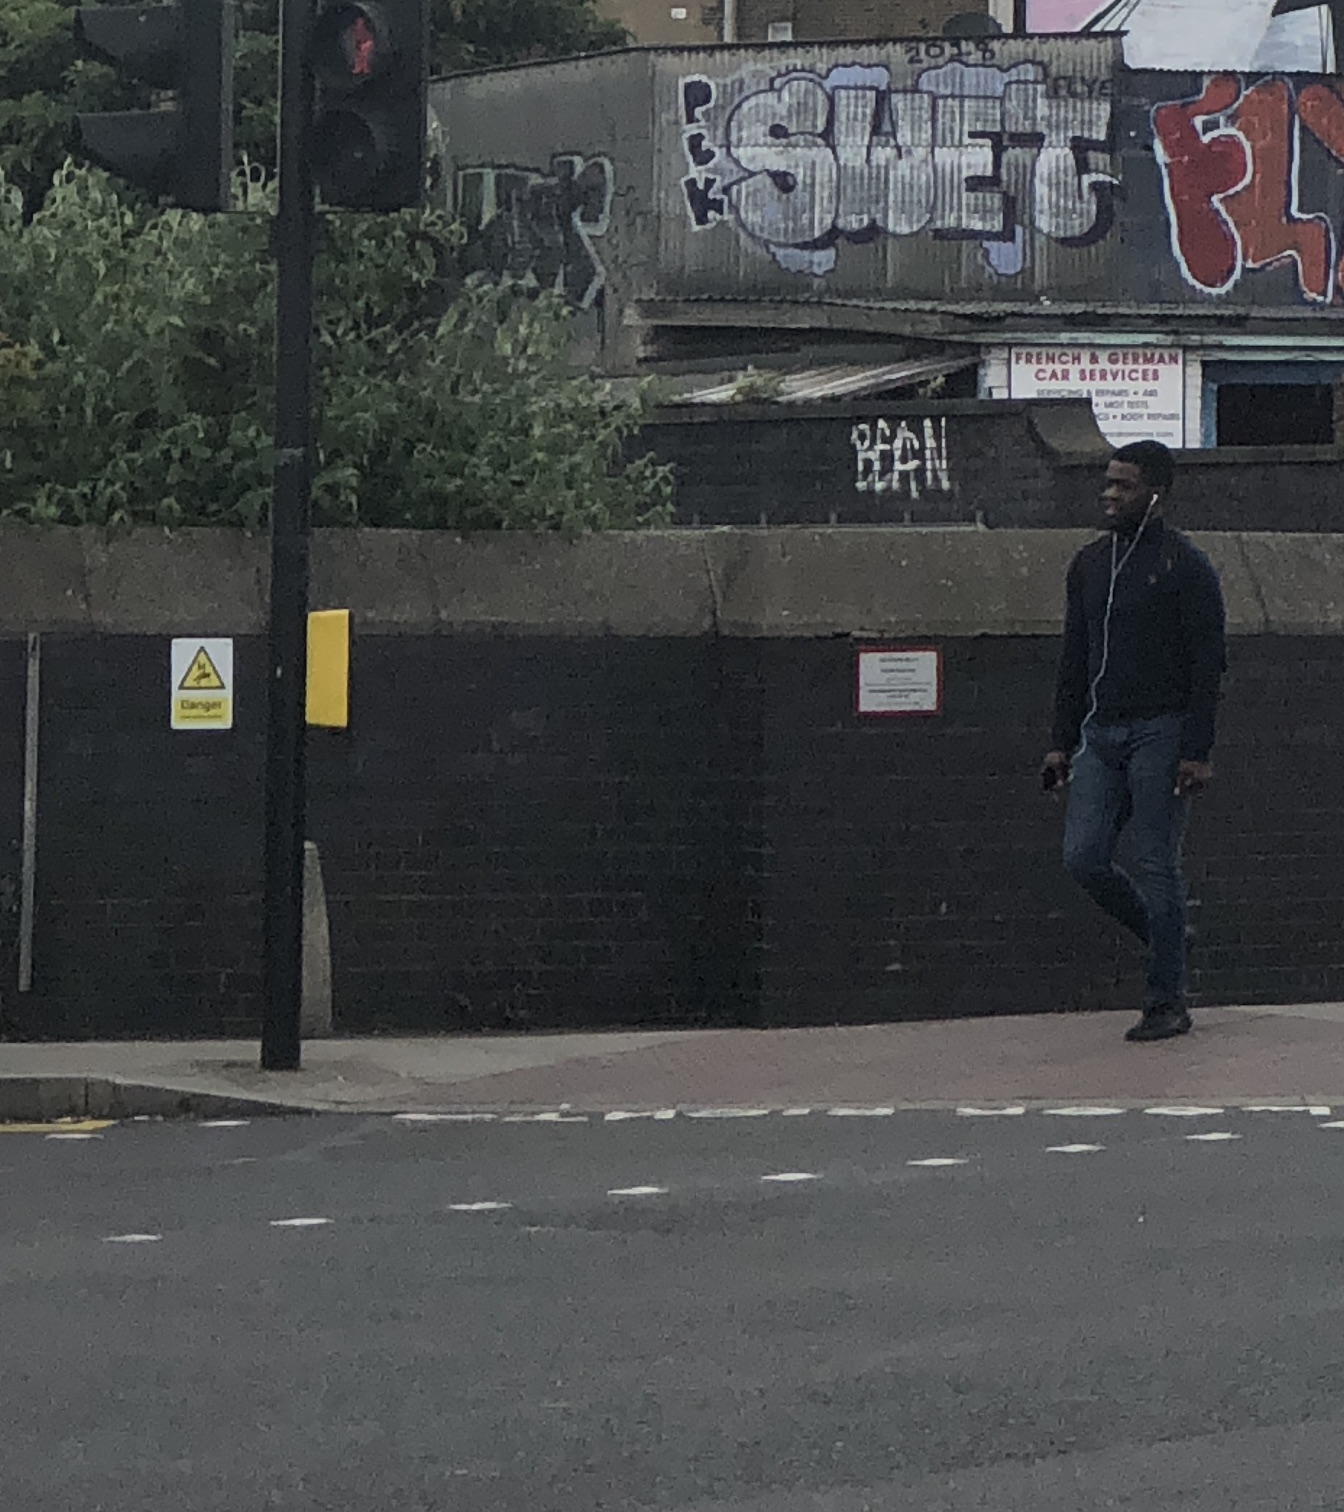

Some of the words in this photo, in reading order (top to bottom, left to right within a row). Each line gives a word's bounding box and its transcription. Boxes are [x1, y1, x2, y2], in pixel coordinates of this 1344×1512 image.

[1015, 352, 1082, 365] FRENCH
[1089, 352, 1100, 365] &
[1107, 352, 1179, 365] GERMAN
[1034, 368, 1070, 381] CAR
[1079, 368, 1160, 381] SERVICES
